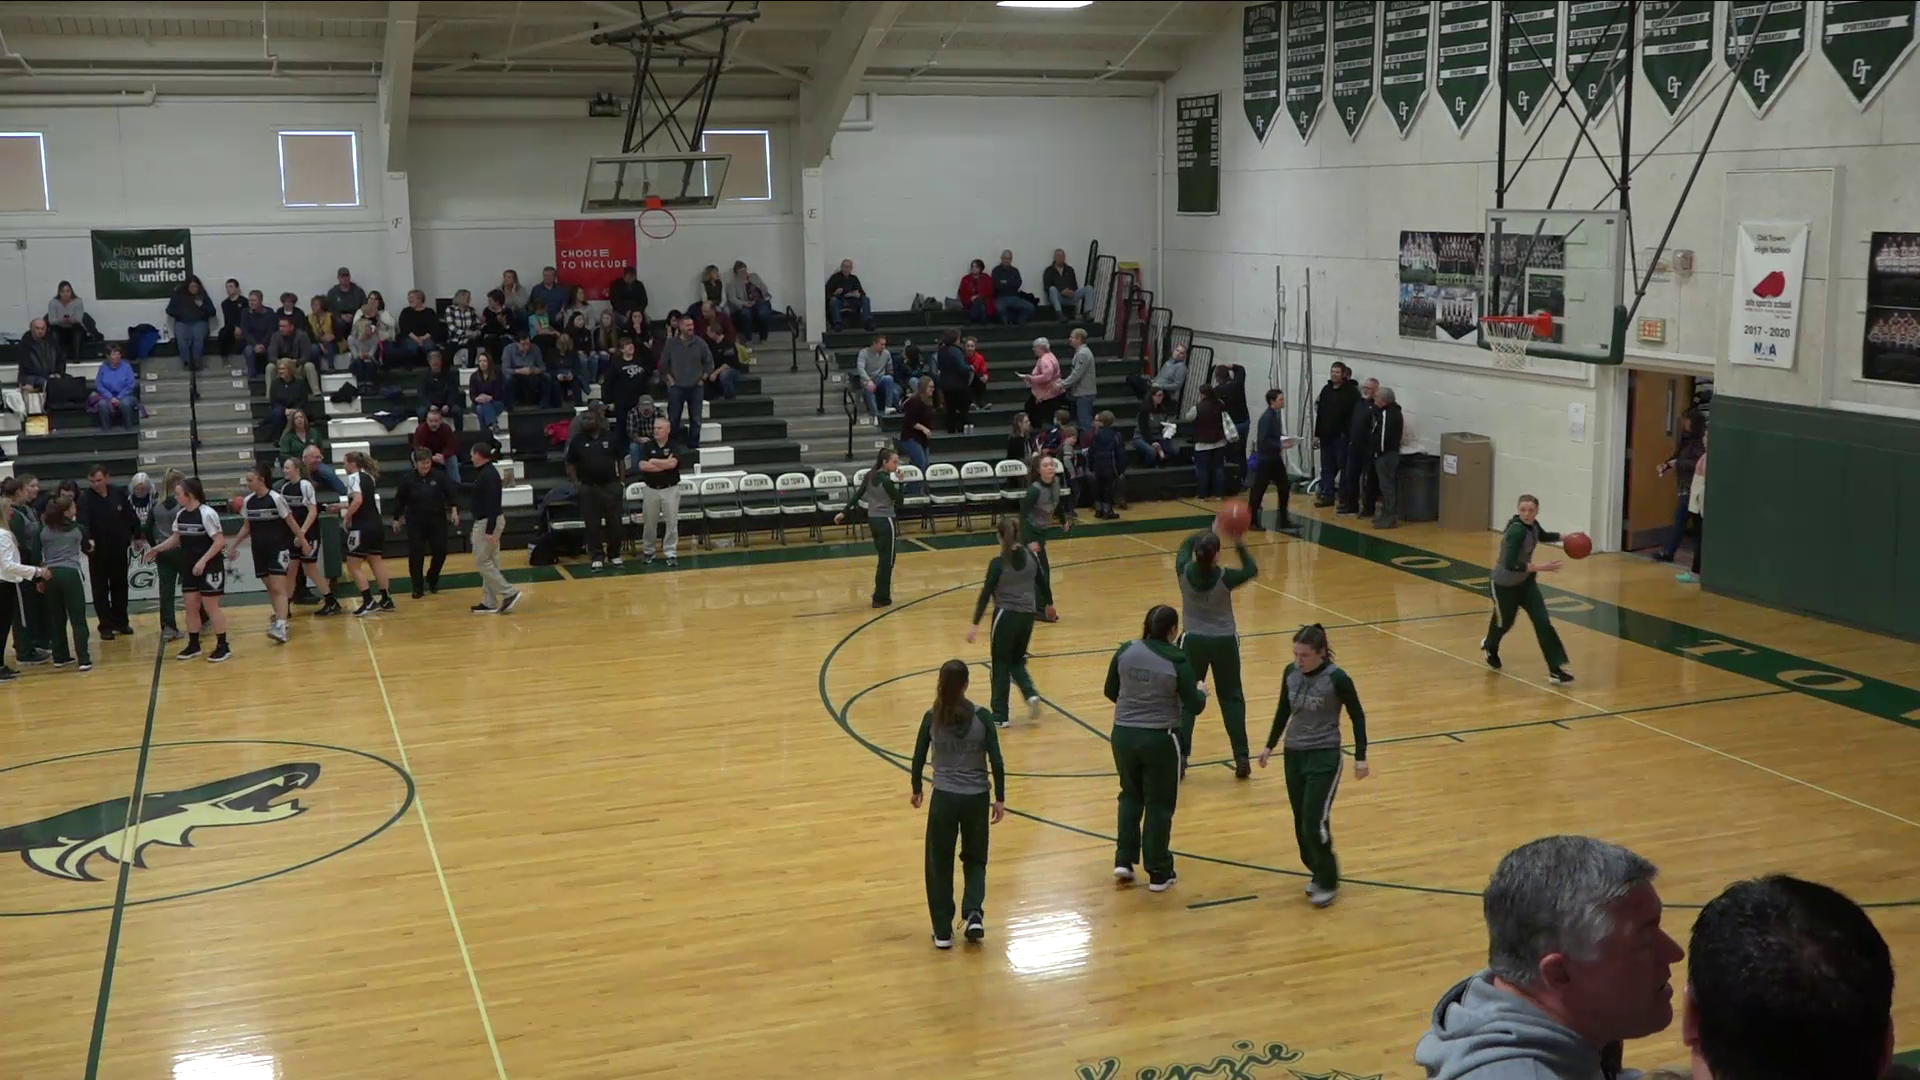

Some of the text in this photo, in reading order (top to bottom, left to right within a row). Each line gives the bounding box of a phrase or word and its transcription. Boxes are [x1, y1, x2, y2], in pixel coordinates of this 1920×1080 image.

[560, 249, 610, 258] CHOOSE
[562, 259, 628, 269] TO INCLUDE
[1744, 325, 1762, 336] 2017
[1769, 327, 1791, 338] 2020
